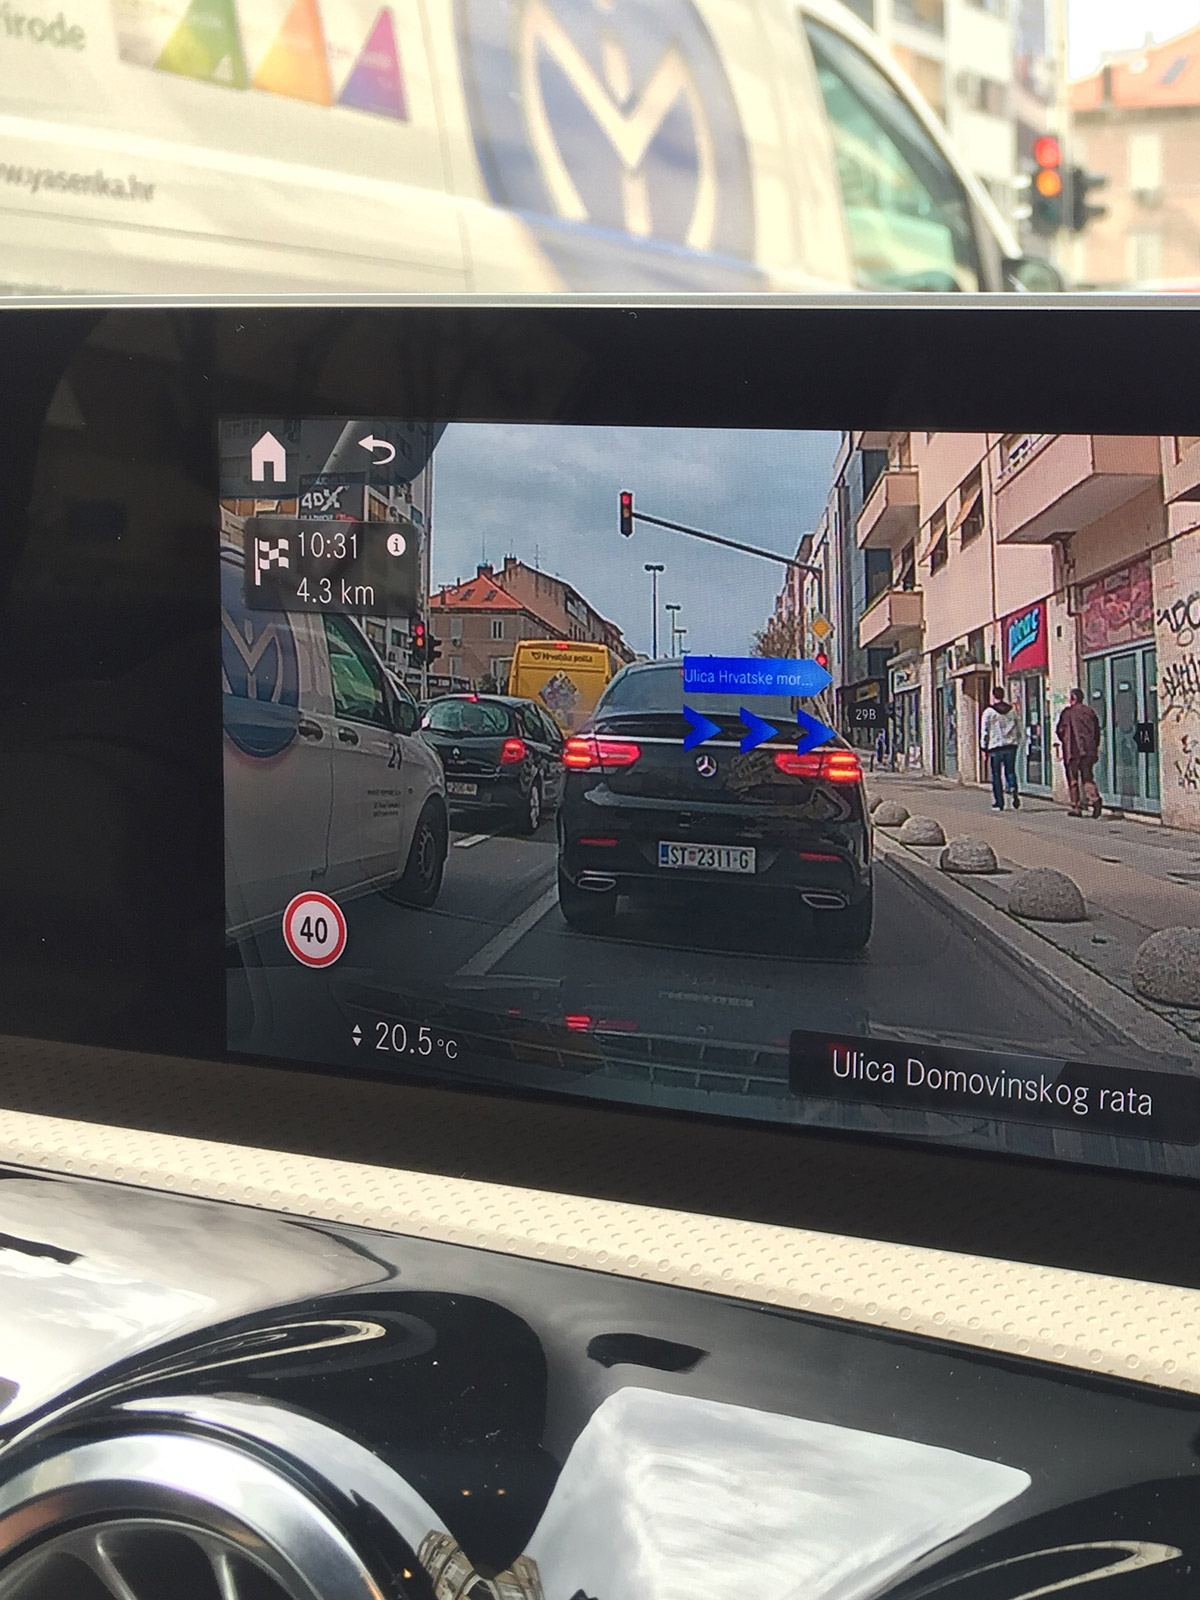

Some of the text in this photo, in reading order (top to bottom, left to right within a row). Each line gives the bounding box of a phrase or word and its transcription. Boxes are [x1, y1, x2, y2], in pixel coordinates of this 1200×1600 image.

[297, 532, 358, 559] 10:31
[296, 577, 375, 606] 4.3 km
[684, 669, 715, 683] Ulica
[719, 670, 773, 685] Hrvatske
[855, 708, 877, 720] 29B
[299, 916, 328, 944] 40
[832, 1048, 1153, 1117] Ulica Domovinskog rata
